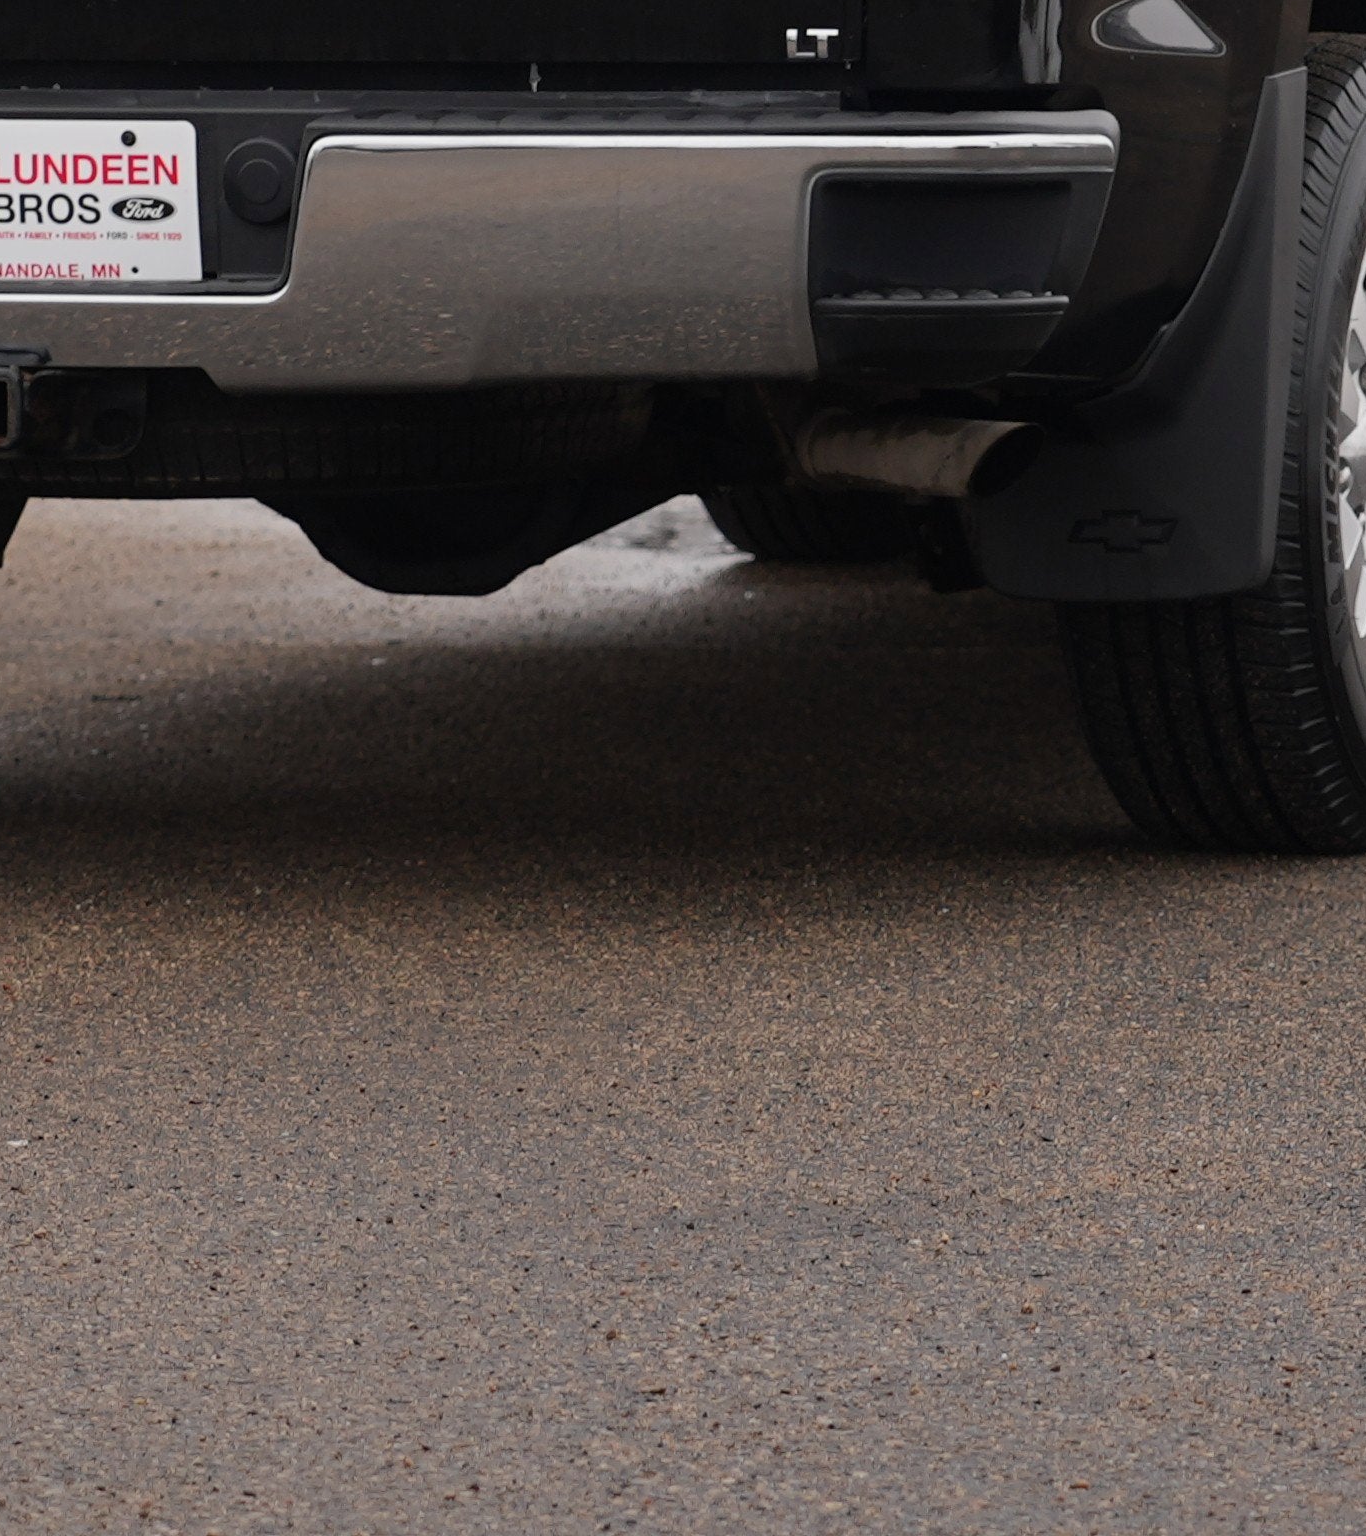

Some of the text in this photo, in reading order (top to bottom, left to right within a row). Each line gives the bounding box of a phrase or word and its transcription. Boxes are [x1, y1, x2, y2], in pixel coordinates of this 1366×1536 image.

[786, 28, 839, 58] LT
[121, 197, 165, 220] Ford
[106, 232, 129, 241] FORD
[136, 233, 161, 241] SINCE
[91, 263, 122, 279] MN
